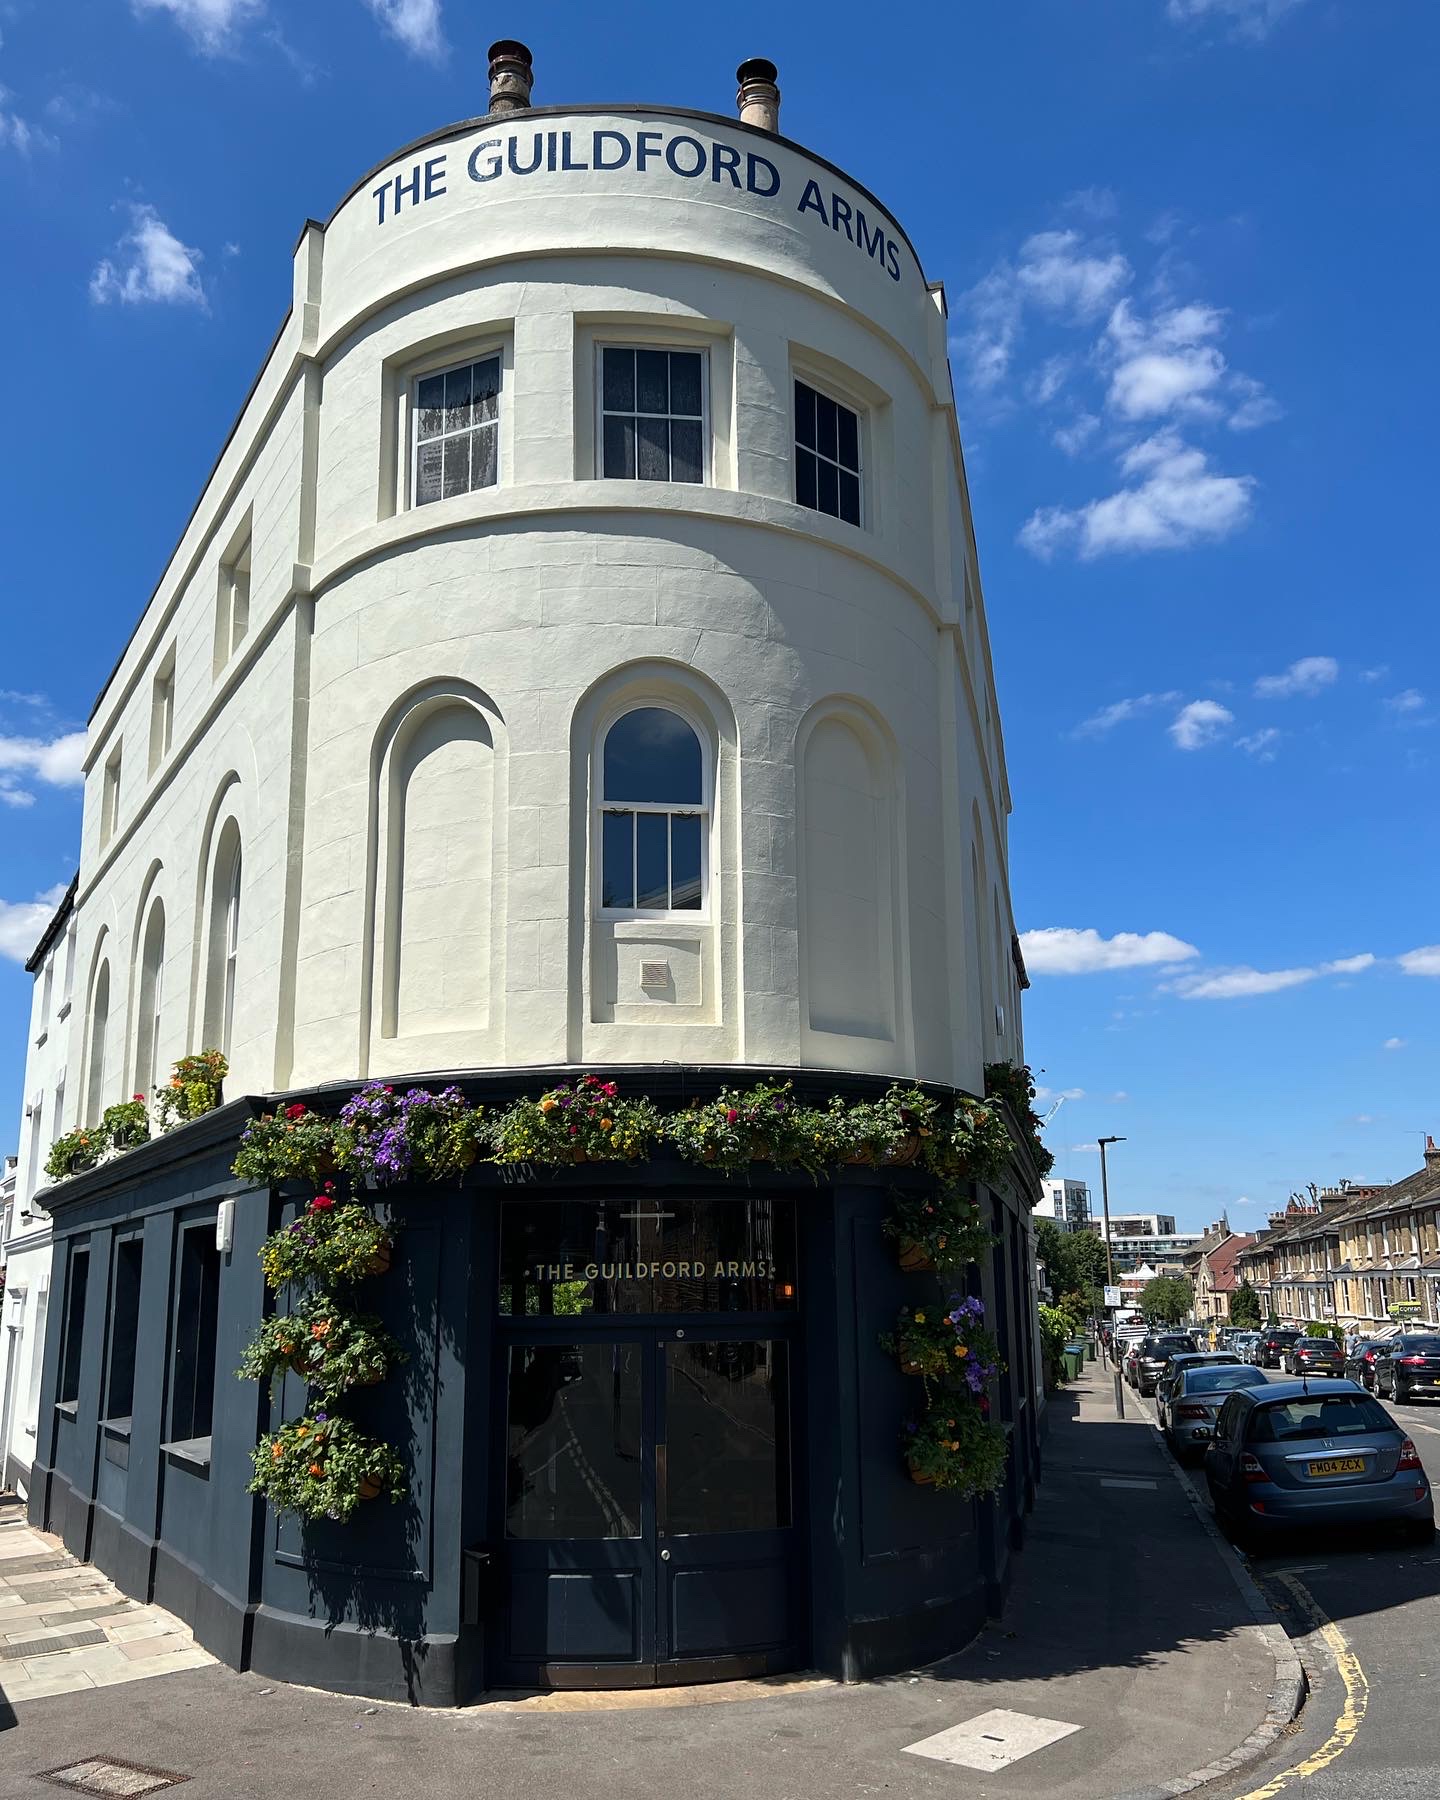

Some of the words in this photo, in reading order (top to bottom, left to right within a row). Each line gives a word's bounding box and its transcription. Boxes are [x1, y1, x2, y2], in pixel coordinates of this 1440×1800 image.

[372, 155, 448, 225] THE
[467, 129, 781, 198] GUILDFORD
[797, 179, 901, 282] ARMS
[536, 1263, 573, 1280] THE
[585, 1261, 705, 1279] GUILDFORD
[714, 1260, 766, 1277] ARMS
[1309, 1460, 1338, 1474] FM04
[1341, 1459, 1362, 1471] ZCX
